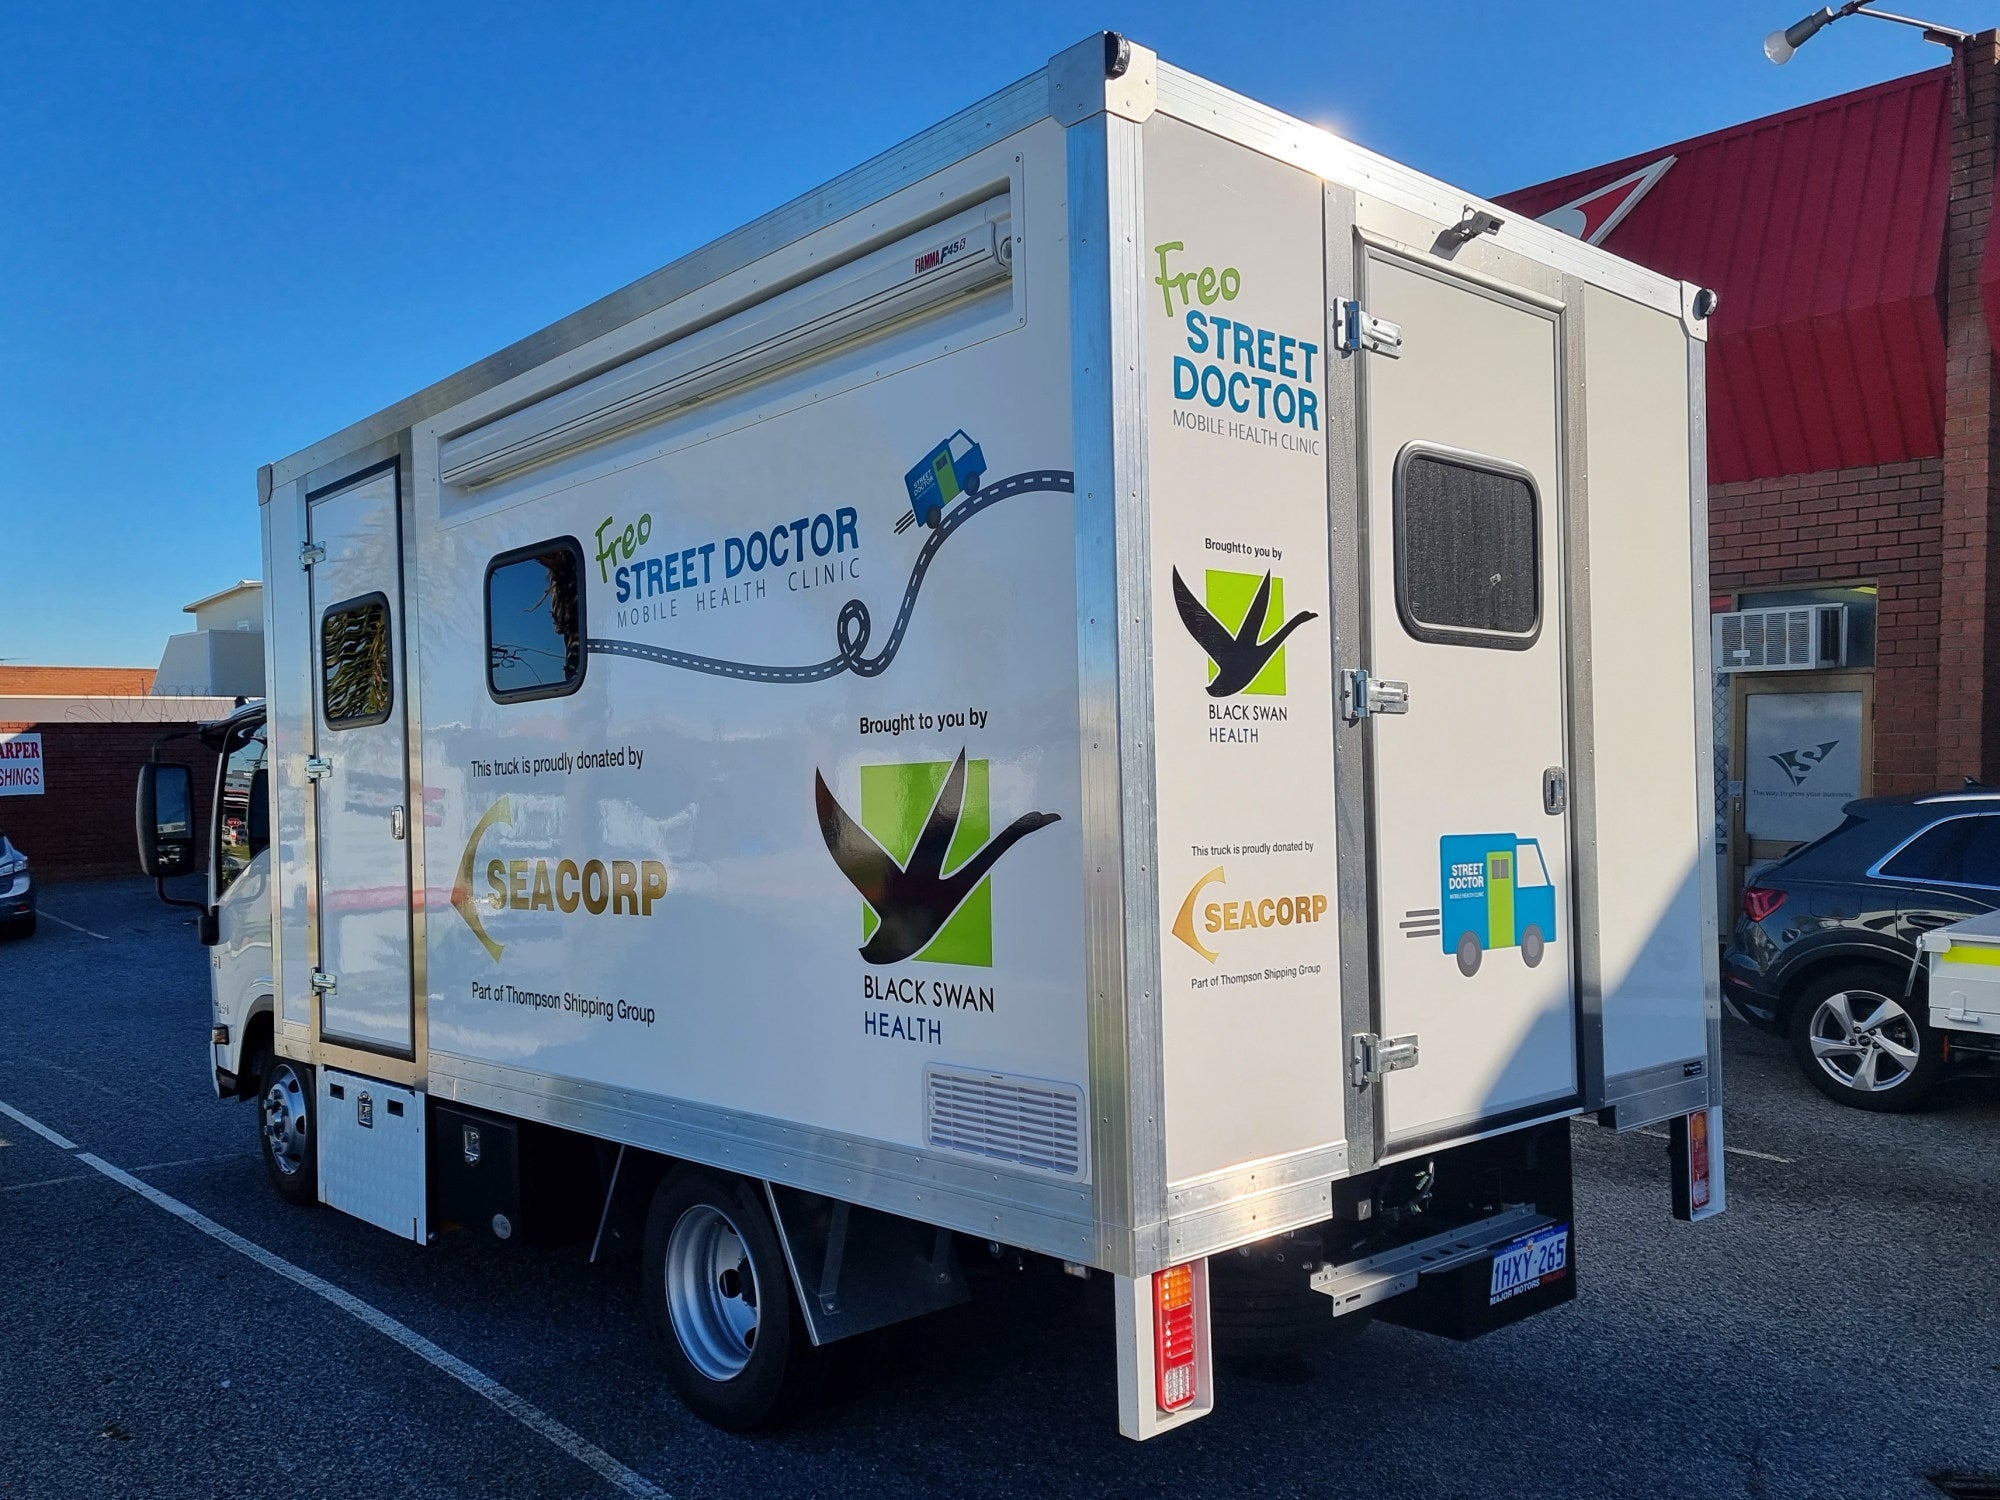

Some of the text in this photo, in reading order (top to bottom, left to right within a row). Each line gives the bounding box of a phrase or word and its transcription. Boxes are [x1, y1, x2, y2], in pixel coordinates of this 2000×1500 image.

[915, 250, 940, 275] FIAMMA
[1154, 241, 1241, 317] Freo
[1186, 310, 1318, 383] STREET
[1173, 355, 1319, 431] DOCTOR
[1173, 409, 1320, 456] MOBILE HEALTH CLINIC
[914, 469, 931, 488] STREET
[914, 476, 933, 496] DOCTOR
[595, 513, 652, 583] Freo
[616, 506, 859, 603] STREET DOCTOR
[1205, 538, 1283, 560] Brought to you by
[617, 557, 861, 628] MOBILE HEALTH CLINIC
[859, 707, 988, 736] Brought to you by
[1208, 704, 1288, 721] BLACK SWAN
[1209, 727, 1259, 743] HEALTH
[471, 746, 644, 777] This truck is proudly donated by
[1191, 841, 1314, 857] This truck is proudly donated by
[1449, 876, 1485, 890] DOCTOR
[1451, 863, 1484, 877] STREET
[486, 858, 668, 917] SEACORP
[1204, 894, 1328, 933] SEACORP
[1191, 963, 1321, 989] Part of Thompson Shipping Group
[471, 981, 655, 1027] Part of Thompson Shipping Group
[863, 974, 994, 1013] BLACK SWAN
[864, 1010, 942, 1045] HEALTH
[1489, 1279, 1541, 1306] MAJOR MOTORS
